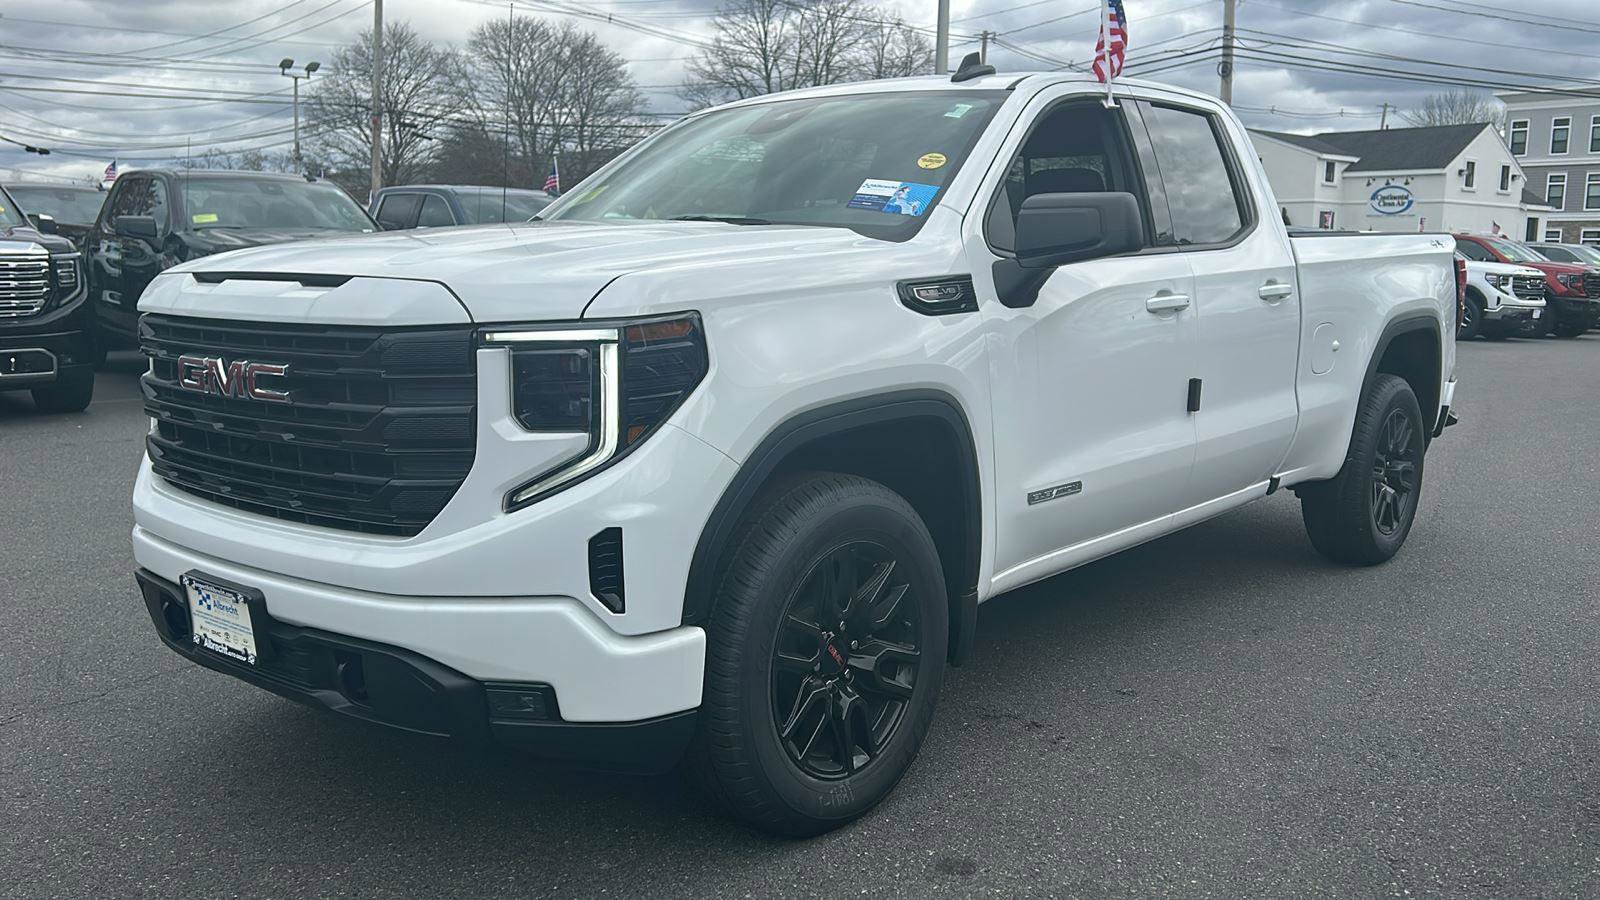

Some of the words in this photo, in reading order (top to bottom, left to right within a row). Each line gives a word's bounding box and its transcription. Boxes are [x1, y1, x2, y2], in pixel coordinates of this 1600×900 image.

[178, 354, 291, 403] GMC
[213, 600, 239, 616] Albrecht
[203, 638, 228, 655] Albrecht
